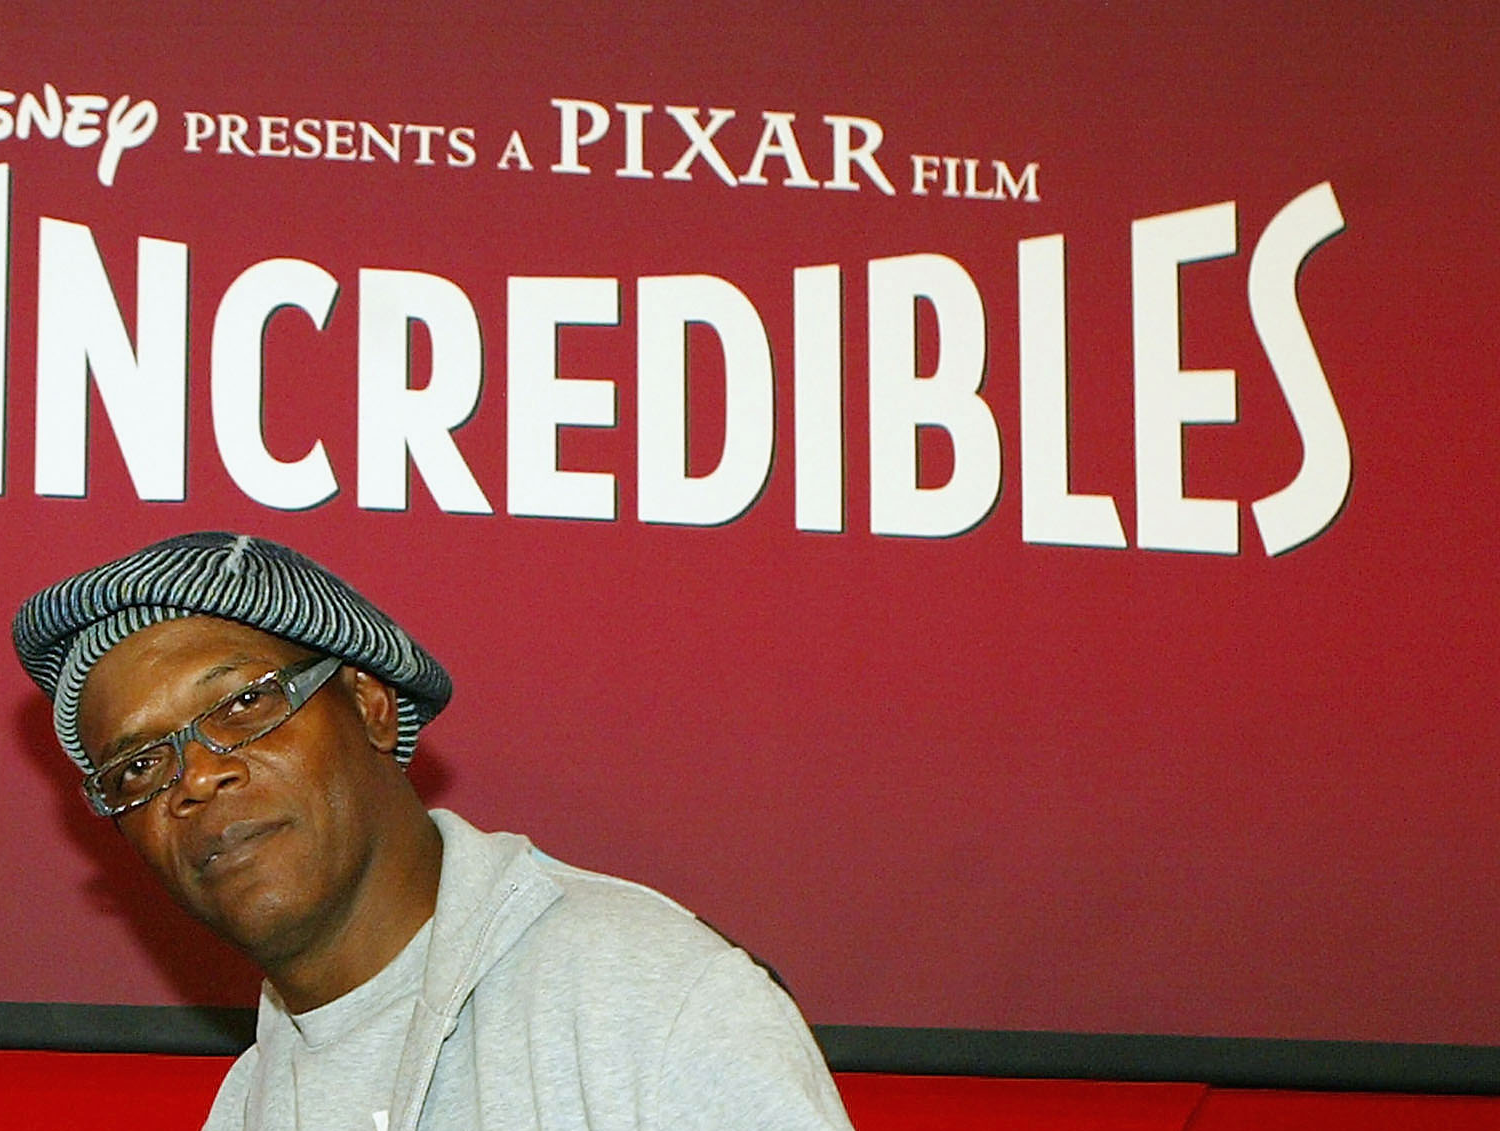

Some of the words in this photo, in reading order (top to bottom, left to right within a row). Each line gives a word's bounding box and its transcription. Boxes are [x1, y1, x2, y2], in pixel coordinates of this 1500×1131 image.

[183, 111, 476, 169] PRESENTS
[497, 130, 534, 172] A
[550, 98, 896, 197] PIXAR
[910, 154, 1041, 203] FILM
